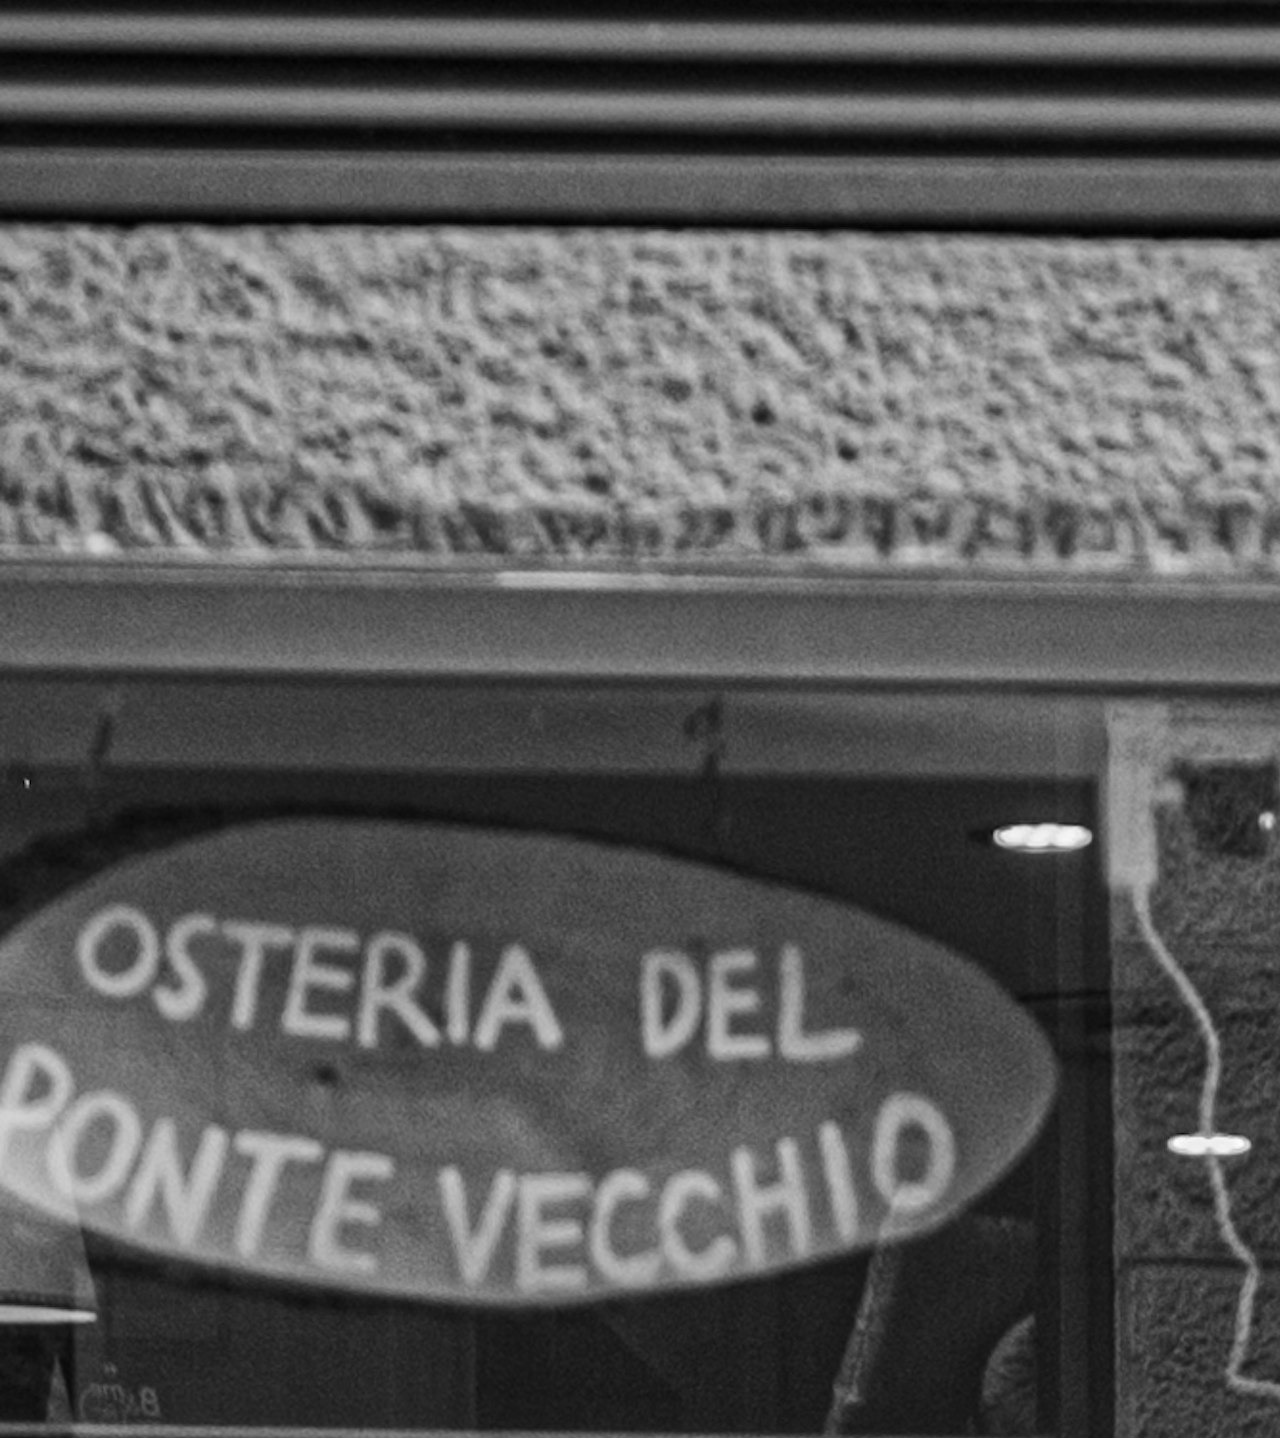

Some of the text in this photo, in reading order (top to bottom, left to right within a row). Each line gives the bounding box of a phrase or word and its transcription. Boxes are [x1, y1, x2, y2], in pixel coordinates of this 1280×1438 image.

[75, 902, 864, 1062] OSTERIA DEL
[0, 1041, 957, 1292] PONTE VECCHIO
